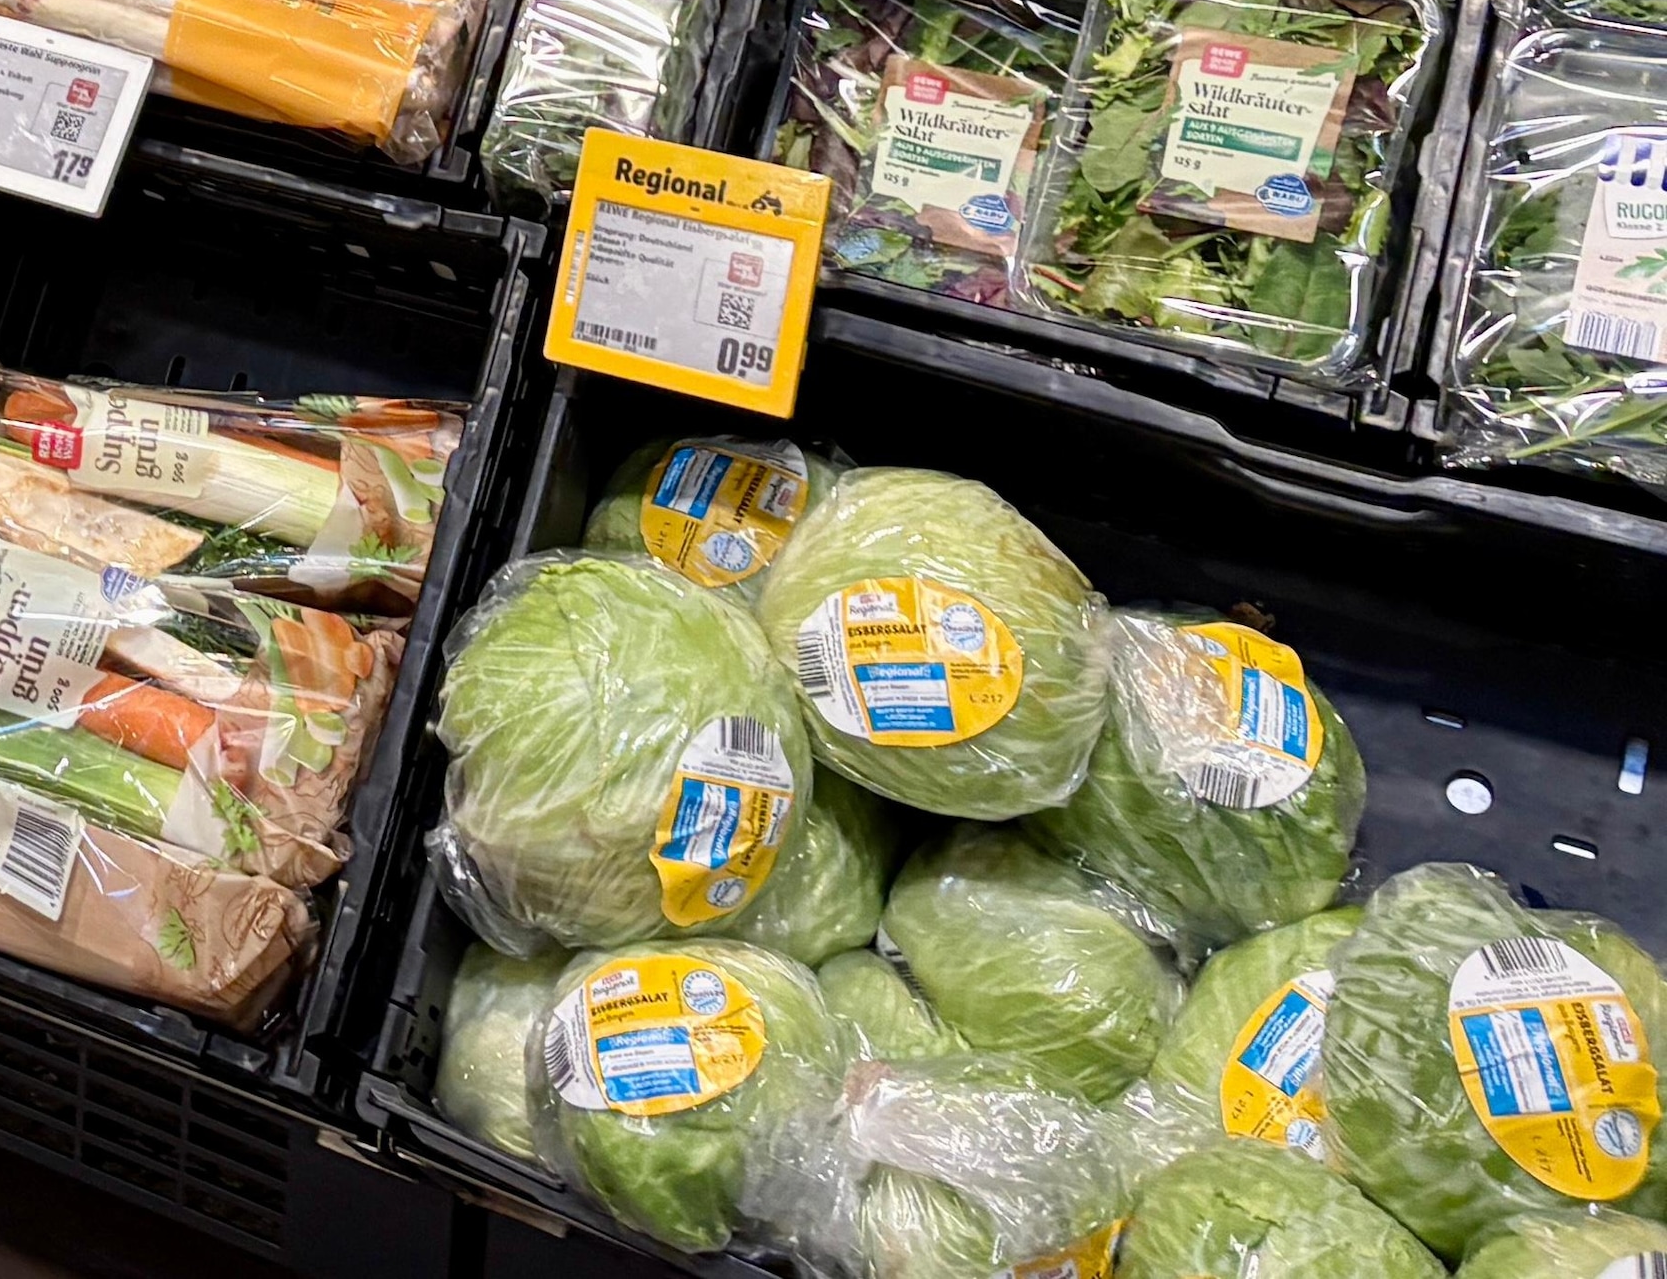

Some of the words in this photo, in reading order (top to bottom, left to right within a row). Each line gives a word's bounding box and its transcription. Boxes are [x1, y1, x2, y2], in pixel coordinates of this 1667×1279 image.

[1186, 101, 1231, 119] salat
[1193, 81, 1314, 117] Wildkräuter-
[893, 124, 936, 144] salat
[899, 107, 1010, 141] Wildkräuter-
[52, 149, 94, 182] 1.79
[614, 157, 728, 206] Regional
[631, 208, 680, 230] Regional
[716, 336, 774, 378] 0.99
[95, 393, 130, 475] Suppe
[135, 417, 163, 481] grün
[848, 623, 927, 639] EISBERGSALAT
[12, 634, 52, 705] grün
[590, 992, 669, 1017] EISBERGSALAT
[1570, 1001, 1616, 1095] EISBERGSALAT
